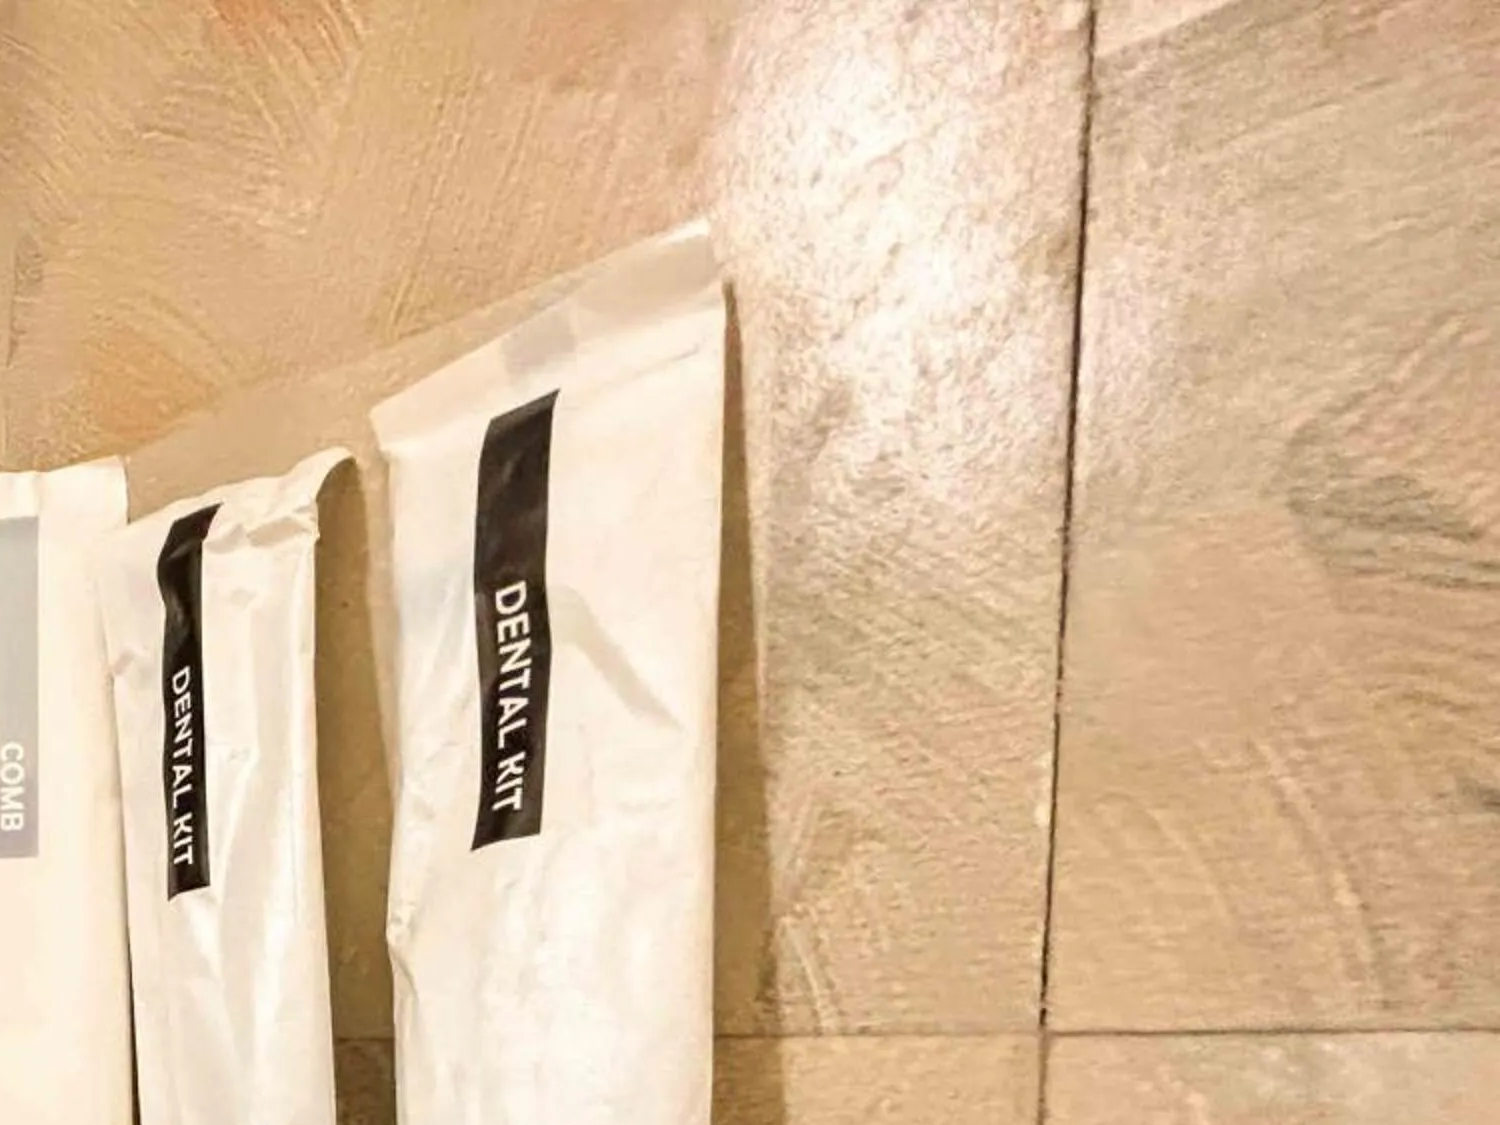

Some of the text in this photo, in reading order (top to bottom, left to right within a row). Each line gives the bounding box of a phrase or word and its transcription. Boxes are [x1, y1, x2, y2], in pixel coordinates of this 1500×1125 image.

[0, 742, 26, 832] COMB
[171, 665, 193, 865] DENTAL KIT
[492, 580, 532, 812] DENTAL KIT
